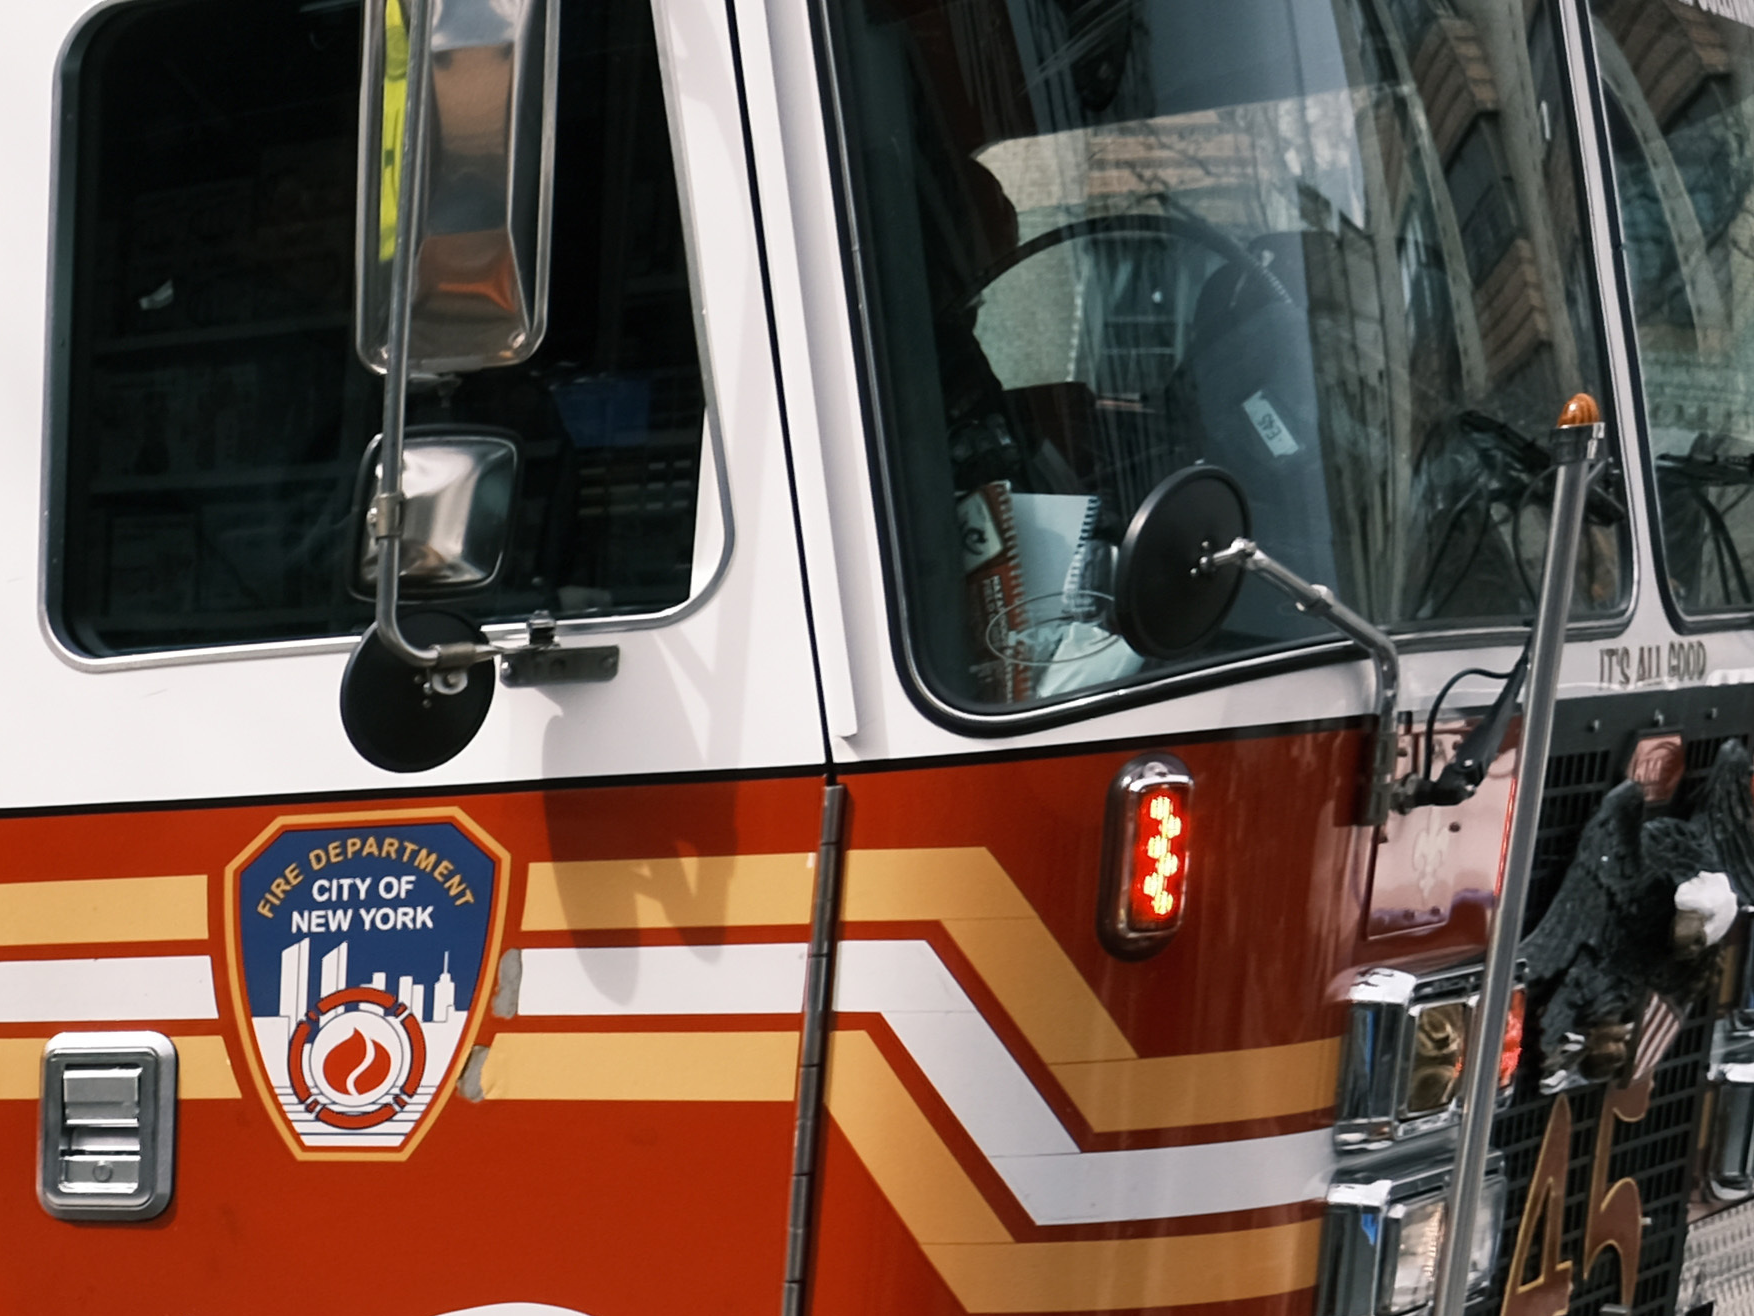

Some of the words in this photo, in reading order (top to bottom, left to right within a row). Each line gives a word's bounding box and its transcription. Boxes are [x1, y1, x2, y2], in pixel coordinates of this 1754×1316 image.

[1599, 646, 1630, 690] IT'S
[1636, 644, 1661, 681] ALL
[1668, 640, 1707, 682] GOOD
[256, 863, 304, 919] FIRE
[308, 836, 475, 907] DEPARTMENT
[311, 877, 373, 902] CITY
[378, 875, 417, 900] OF
[291, 908, 353, 934] NEW
[358, 905, 435, 931] YORK
